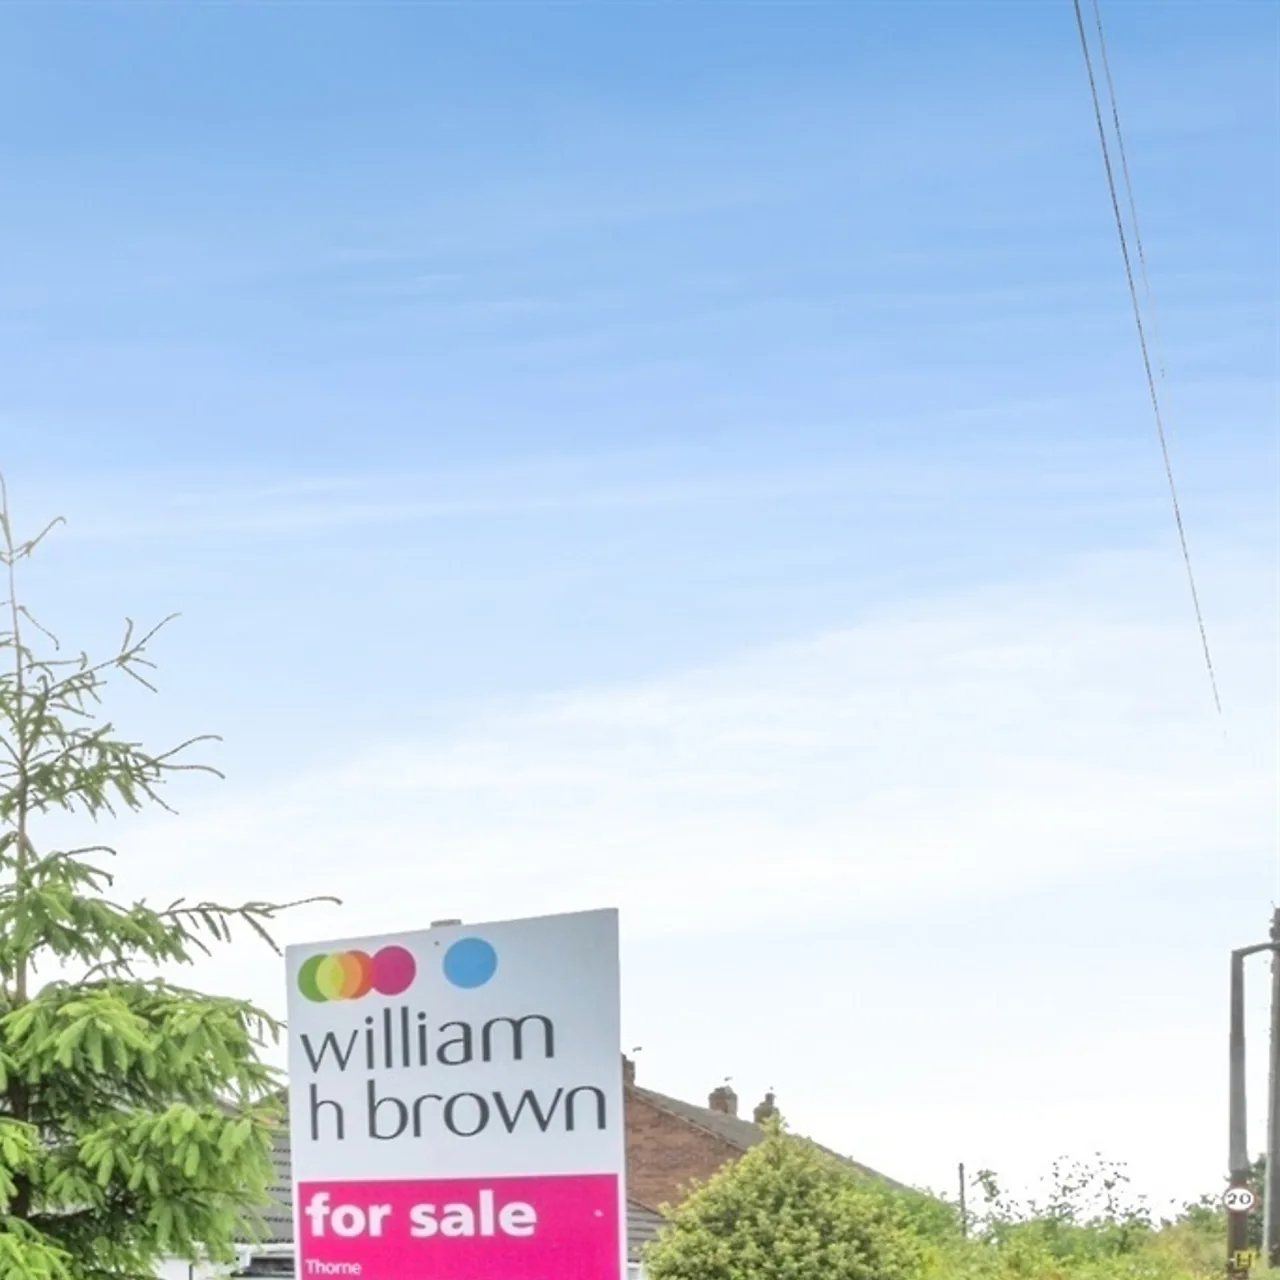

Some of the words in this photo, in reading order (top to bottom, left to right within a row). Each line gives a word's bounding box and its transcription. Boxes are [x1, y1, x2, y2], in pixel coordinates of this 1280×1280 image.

[299, 1005, 555, 1074] william
[309, 1082, 345, 1141] h
[366, 1078, 607, 1141] brown
[304, 1191, 392, 1238] for
[409, 1188, 538, 1238] sale
[1227, 1192, 1251, 1205] 20
[304, 1258, 362, 1276] Thorne
